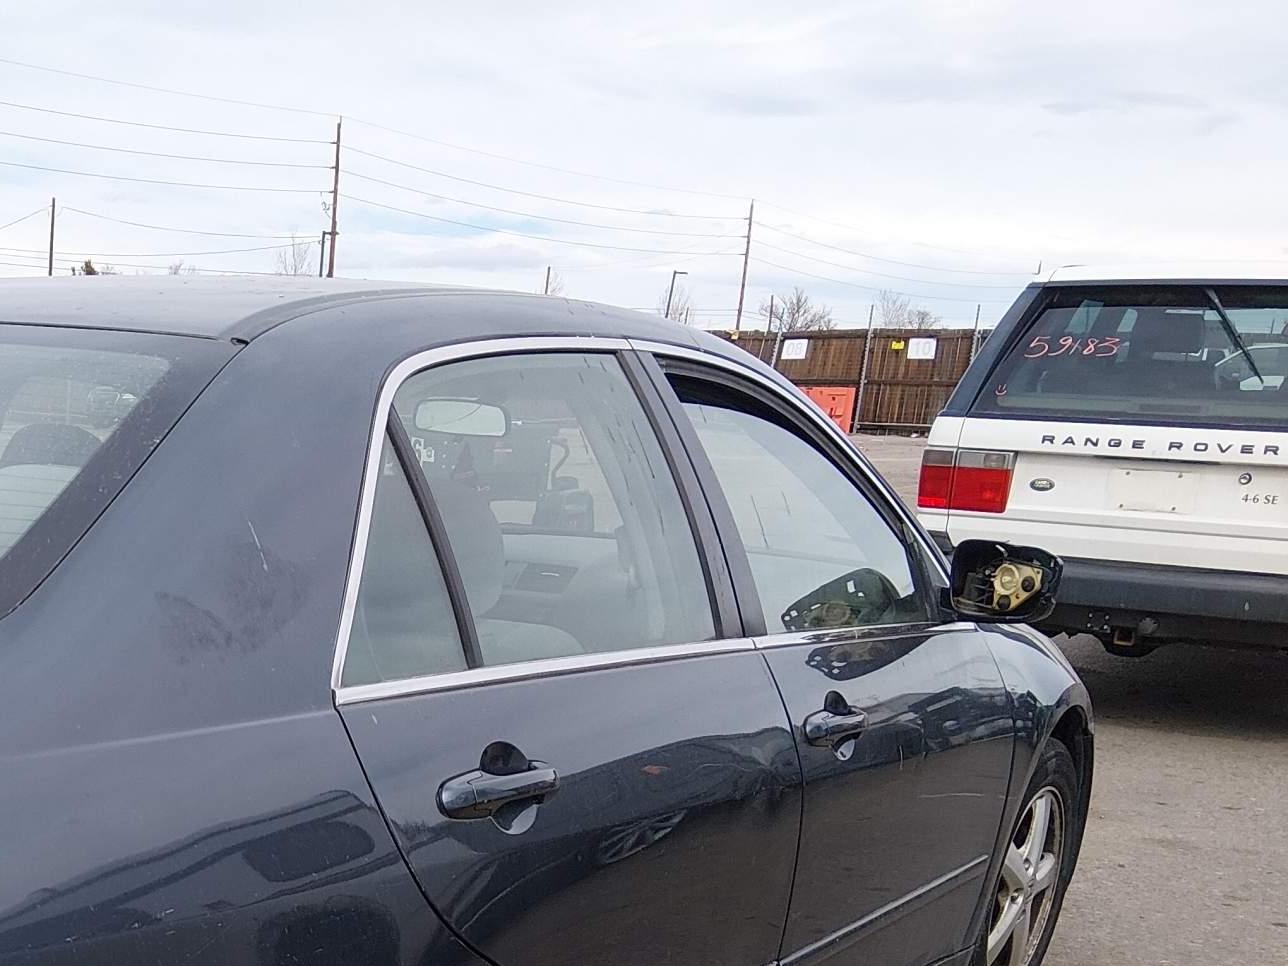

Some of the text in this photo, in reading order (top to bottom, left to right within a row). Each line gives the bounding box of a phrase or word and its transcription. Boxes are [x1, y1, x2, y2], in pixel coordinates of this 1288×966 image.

[1024, 336, 1120, 358] 59183
[1041, 434, 1280, 456] RANGE ROVER
[1263, 494, 1279, 505] SE
